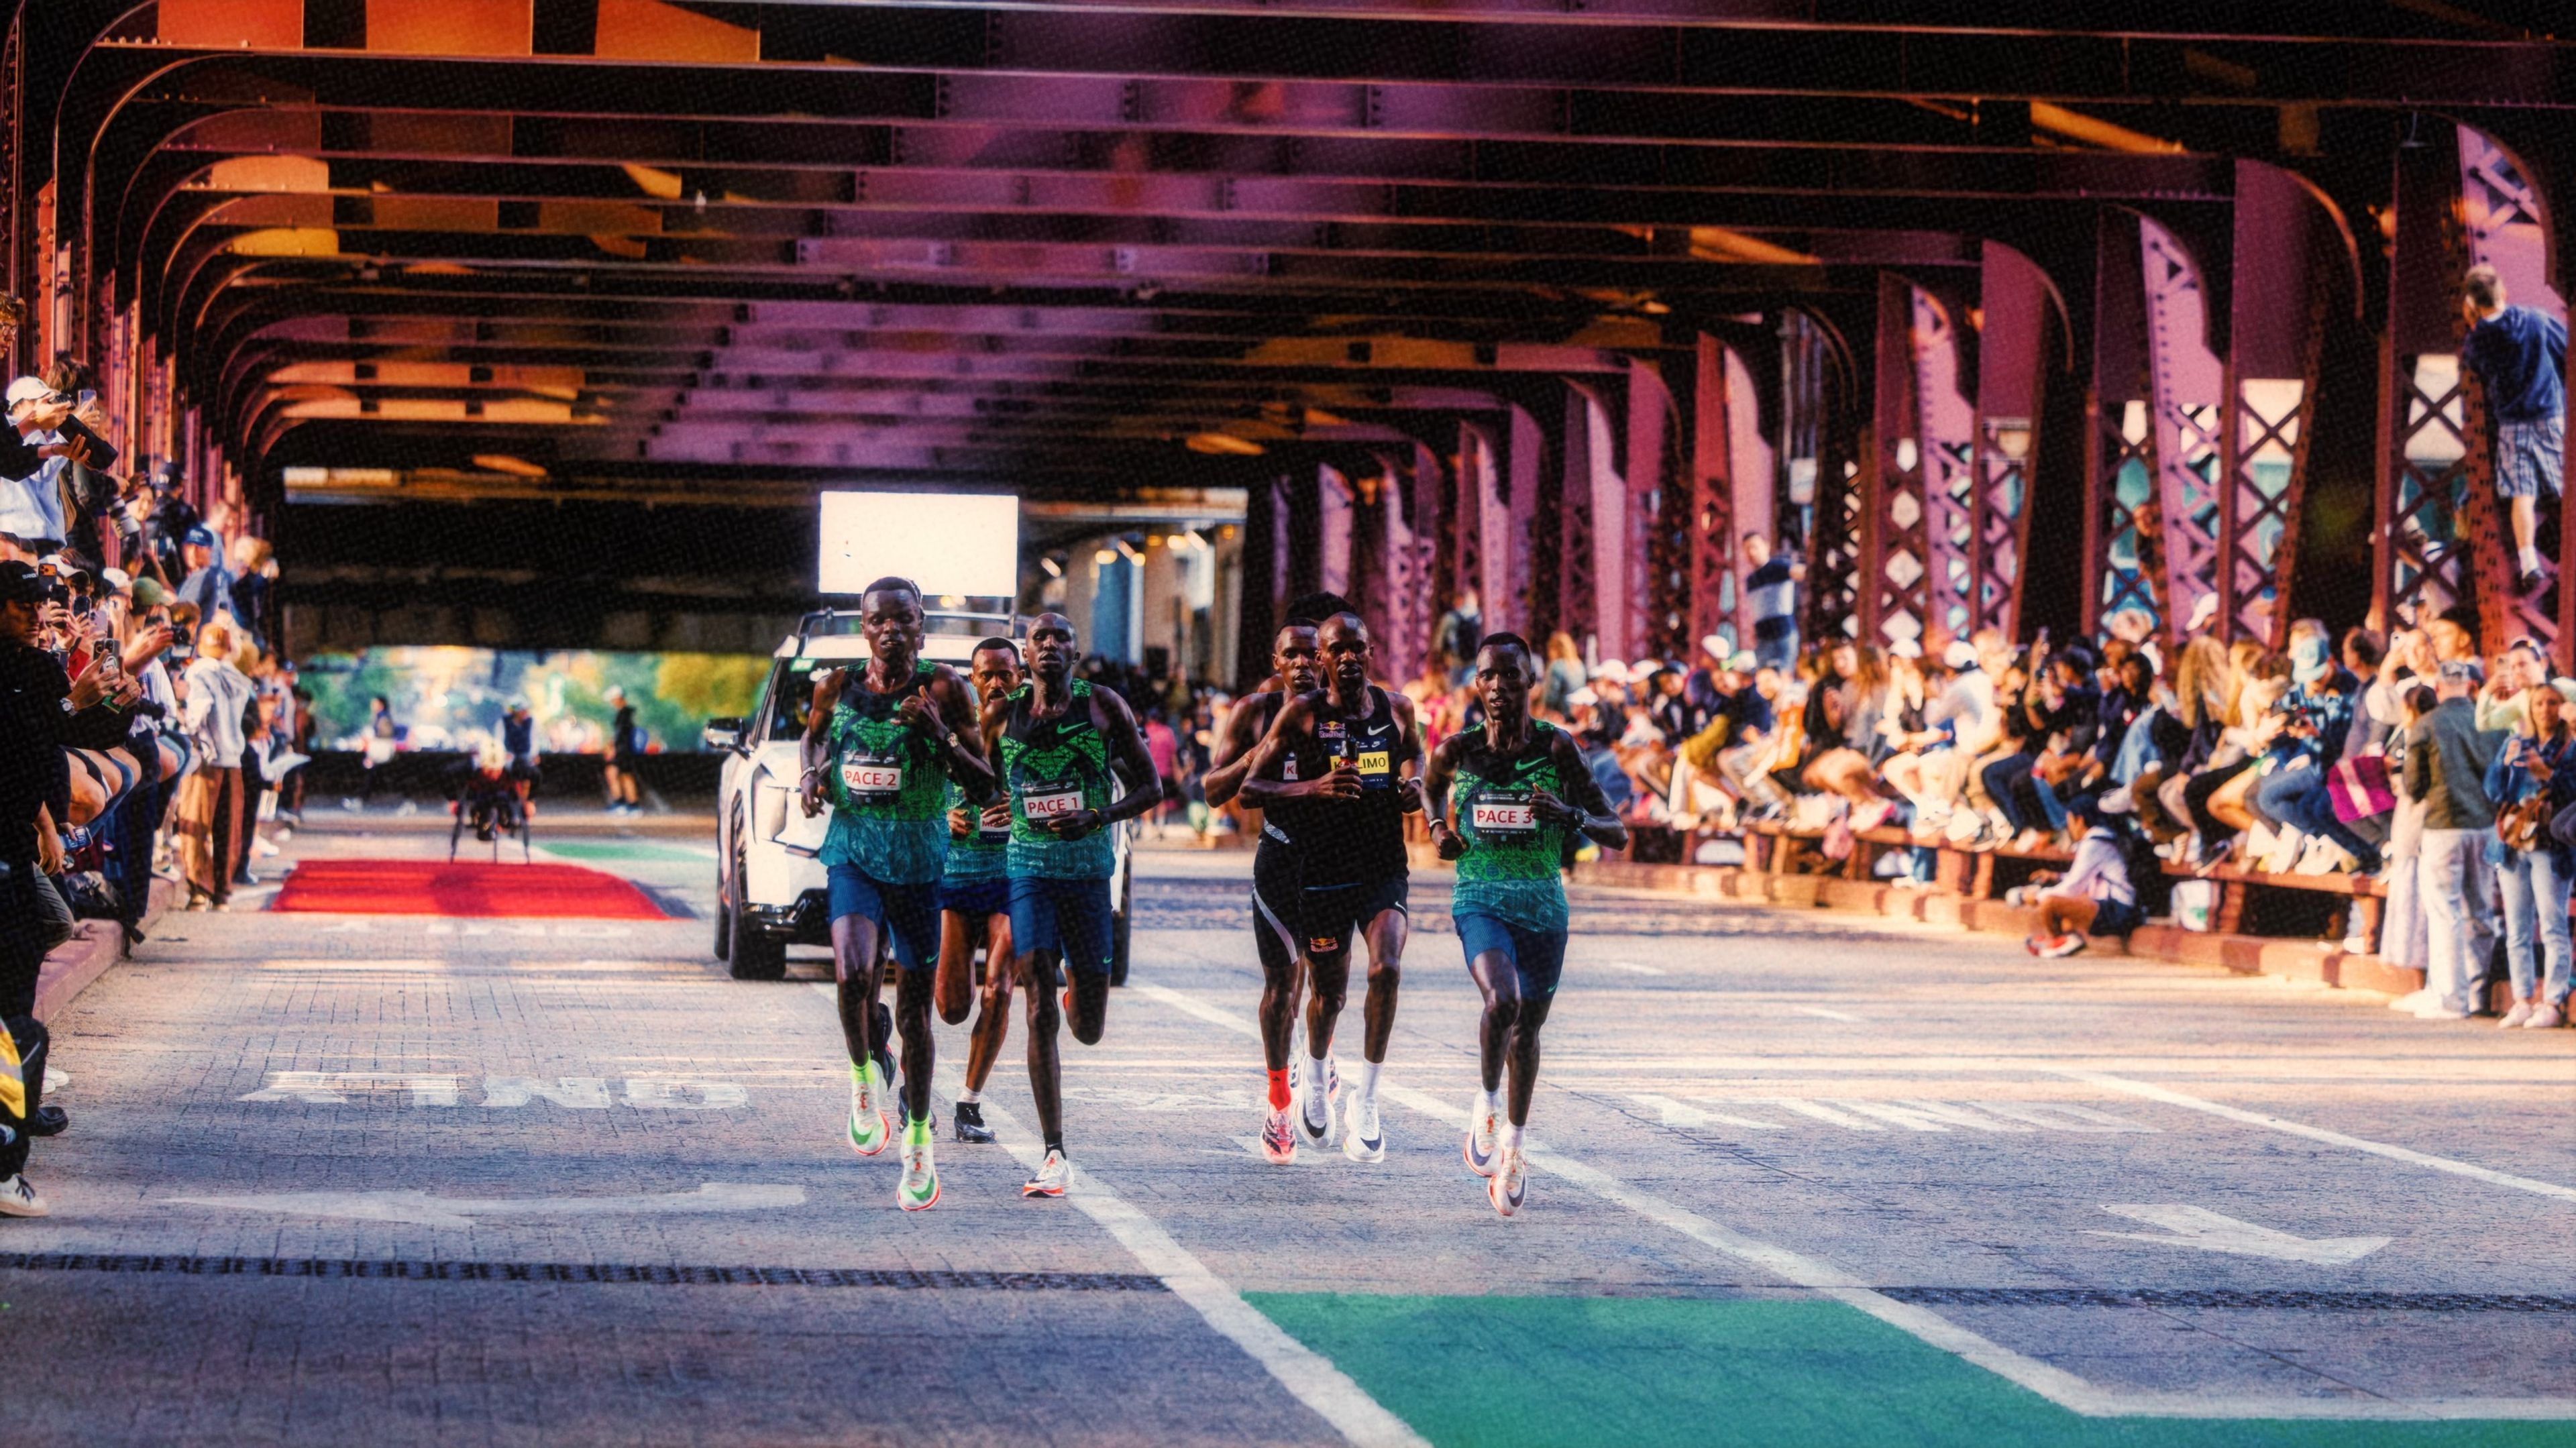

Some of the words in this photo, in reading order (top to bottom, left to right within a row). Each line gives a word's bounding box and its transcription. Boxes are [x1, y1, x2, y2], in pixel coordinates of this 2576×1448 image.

[845, 771, 882, 785] PACE
[887, 773, 897, 786] 2
[1028, 798, 1066, 813] PACE
[1071, 797, 1078, 808] 1
[1477, 810, 1517, 823] PACE
[1523, 810, 1532, 824] 3
